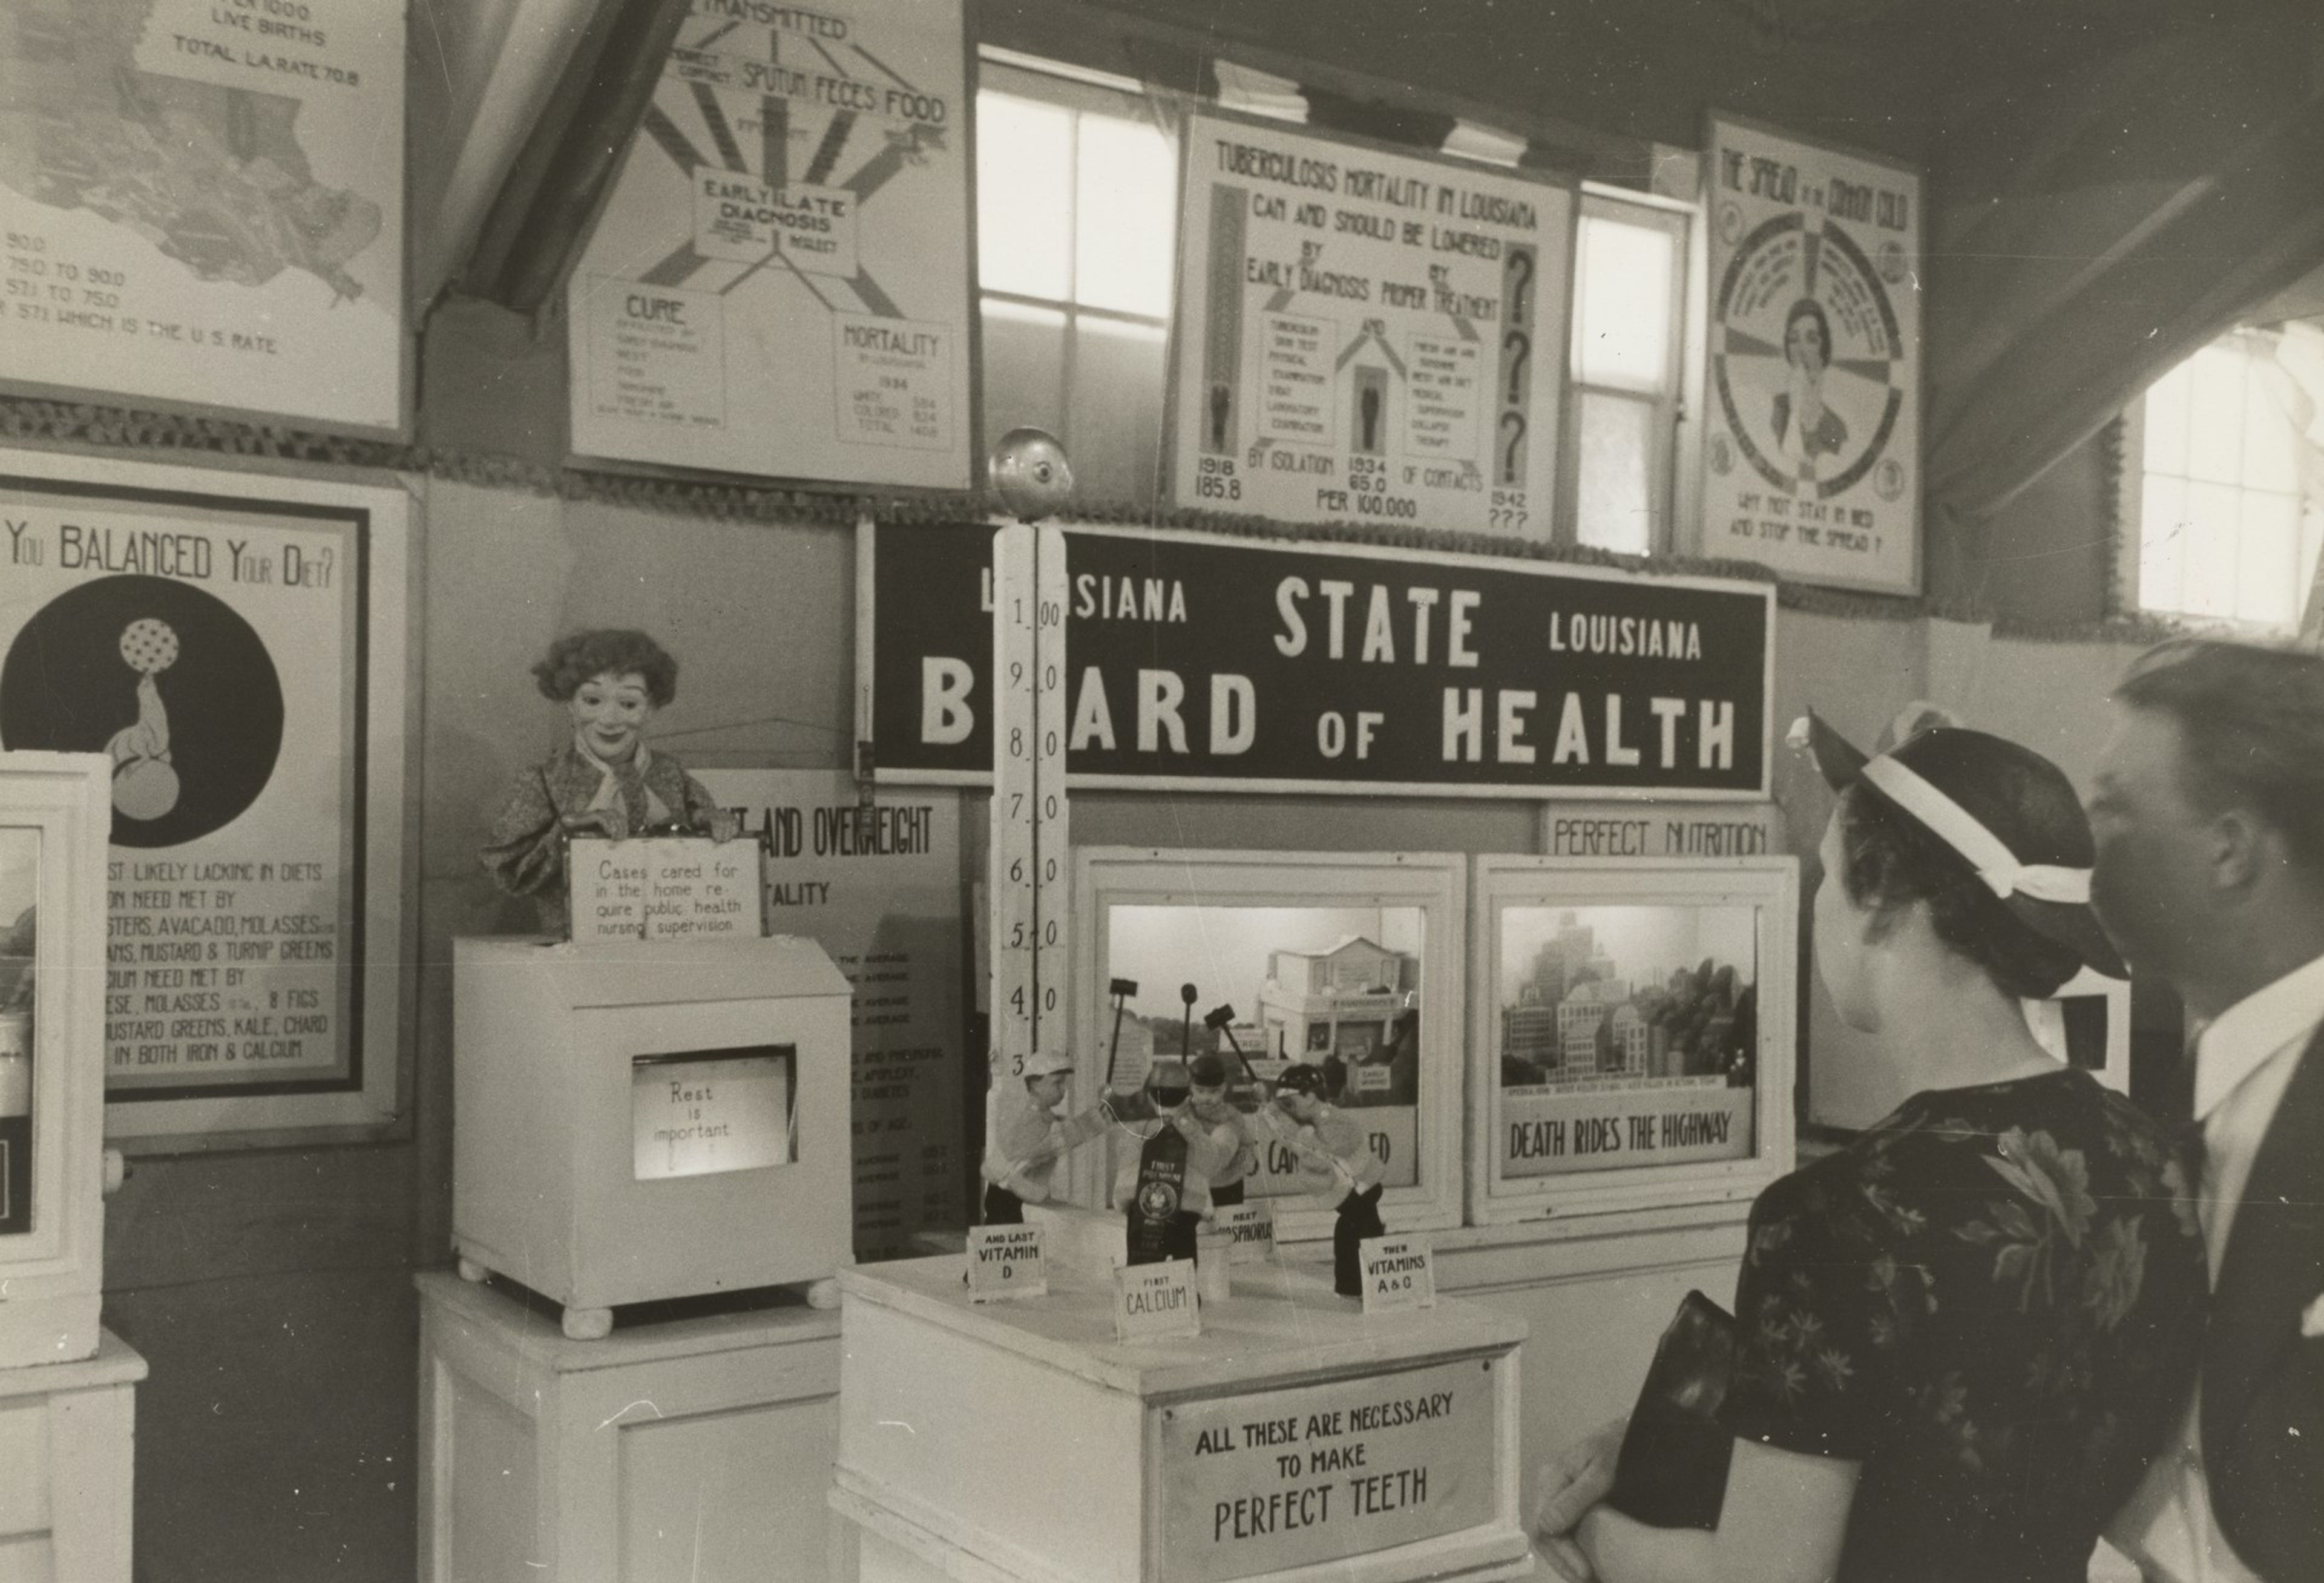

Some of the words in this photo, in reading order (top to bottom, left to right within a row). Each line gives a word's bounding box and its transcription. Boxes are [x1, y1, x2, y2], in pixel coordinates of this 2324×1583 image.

[212, 8, 251, 30] LIVE
[258, 19, 325, 47] BIRTHS
[172, 34, 237, 63] TOTAL
[744, 62, 809, 97] SPUTUM
[816, 77, 875, 111] FECES
[886, 90, 945, 123] FOOD
[1216, 140, 1338, 192] TUBERCULOSIS
[1345, 169, 1430, 210] MORTALITY
[1438, 186, 1454, 214] IN
[1460, 191, 1537, 230] LOUISIANA
[704, 180, 769, 204] EARLY
[782, 194, 845, 217] LATE
[721, 202, 830, 232] DIAGNOSIS
[1253, 193, 1285, 221] CAN
[1294, 204, 1326, 228] AND
[1334, 210, 1395, 241] SHOULD
[1402, 223, 1423, 246] BE
[1431, 228, 1502, 260] LOWERED
[1302, 240, 1323, 257] BY
[1430, 264, 1449, 282] BY
[1247, 258, 1293, 287] EARLY
[1300, 266, 1370, 301] DIAGNOSIS
[1382, 281, 1426, 310] PROPER
[1435, 290, 1498, 321] TREATMENT
[627, 295, 685, 324] CURE
[232, 333, 277, 355] RATE
[844, 325, 939, 357] MORTALITY
[1200, 458, 1233, 476] 1918
[1249, 448, 1268, 469] BY
[1273, 450, 1334, 476] ISOLATION
[1350, 457, 1385, 474] 1934
[1196, 476, 1241, 500] 185.8
[1350, 474, 1386, 494] 65.0
[1404, 466, 1417, 485] OF
[1423, 468, 1483, 493] CONTACTS
[1317, 489, 1348, 512] PER
[1492, 491, 1526, 508] 1942
[1760, 521, 1790, 539] STOP
[61, 525, 211, 578] BALANCED
[1274, 575, 1481, 669] STATE
[1549, 612, 1702, 661] LOUISIANA
[921, 656, 1256, 755] BARD
[1318, 711, 1384, 759] OF
[1442, 687, 1734, 770] HEALTH
[763, 807, 803, 857] AND
[814, 807, 933, 856] OVERWEIGHT
[1555, 819, 1650, 856] PERFECT
[1666, 822, 1767, 856] NUTRITION
[134, 863, 188, 881] LIKELY
[194, 864, 253, 881] LACKING
[260, 864, 274, 881] IN
[281, 863, 322, 881] DIETS
[599, 859, 647, 879] Cases
[661, 865, 701, 878] cared
[714, 862, 738, 878] for
[133, 891, 171, 908] NEED
[180, 891, 206, 908] MET
[215, 891, 235, 908] BY
[596, 886, 606, 897] in
[619, 883, 640, 897] the
[654, 882, 691, 896] home
[596, 905, 632, 918] quire
[644, 900, 683, 921] public
[695, 899, 741, 913] health
[241, 915, 320, 936] MOLASSES
[597, 923, 646, 939] nursing
[657, 920, 732, 937] supervision
[142, 942, 202, 962] MUSTARD
[208, 942, 218, 961] &
[226, 942, 274, 960] TURNIP
[280, 940, 333, 960] GREENS
[145, 969, 182, 988] NEED
[191, 968, 218, 987] MET
[226, 968, 245, 986] BY
[145, 992, 220, 1013] MOLASSES
[269, 991, 278, 1009] 8
[287, 989, 318, 1009] FIGS
[171, 1019, 230, 1038] GREENS,
[234, 1017, 278, 1037] KALE,
[284, 1015, 328, 1034] CHARD
[114, 1046, 130, 1065] IN
[138, 1044, 177, 1065] BOTH
[186, 1043, 218, 1063] IRON
[226, 1043, 235, 1061] &
[244, 1040, 302, 1060] CALCIUM
[670, 1081, 712, 1103] Rest
[688, 1106, 701, 1121] is
[654, 1123, 729, 1146] important
[1510, 1120, 1565, 1159] DEATH
[1575, 1117, 1621, 1155] RIDES
[1627, 1115, 1656, 1150] THE
[1662, 1110, 1733, 1148] HIGHWAY
[1233, 1211, 1257, 1221] NEXT
[985, 1235, 1005, 1244] AND
[1008, 1232, 1034, 1243] LAST
[1384, 1245, 1407, 1254] THEN
[979, 1245, 1038, 1262] VITAMIN
[1003, 1265, 1012, 1279] D
[1368, 1255, 1425, 1276] VITAMINS
[1144, 1276, 1169, 1286] FIRST
[1378, 1279, 1388, 1293] A
[1391, 1280, 1399, 1290] &
[1126, 1286, 1187, 1315] CALCIUM
[1195, 1430, 1236, 1457] ALL
[1242, 1418, 1298, 1448] THESE
[1305, 1411, 1342, 1440] ARE
[1349, 1392, 1453, 1434] NECESSARY
[1276, 1455, 1301, 1478] TO
[1311, 1443, 1366, 1474] MAKE
[1214, 1485, 1332, 1542] PERFECT
[1350, 1467, 1428, 1516] TEETH
